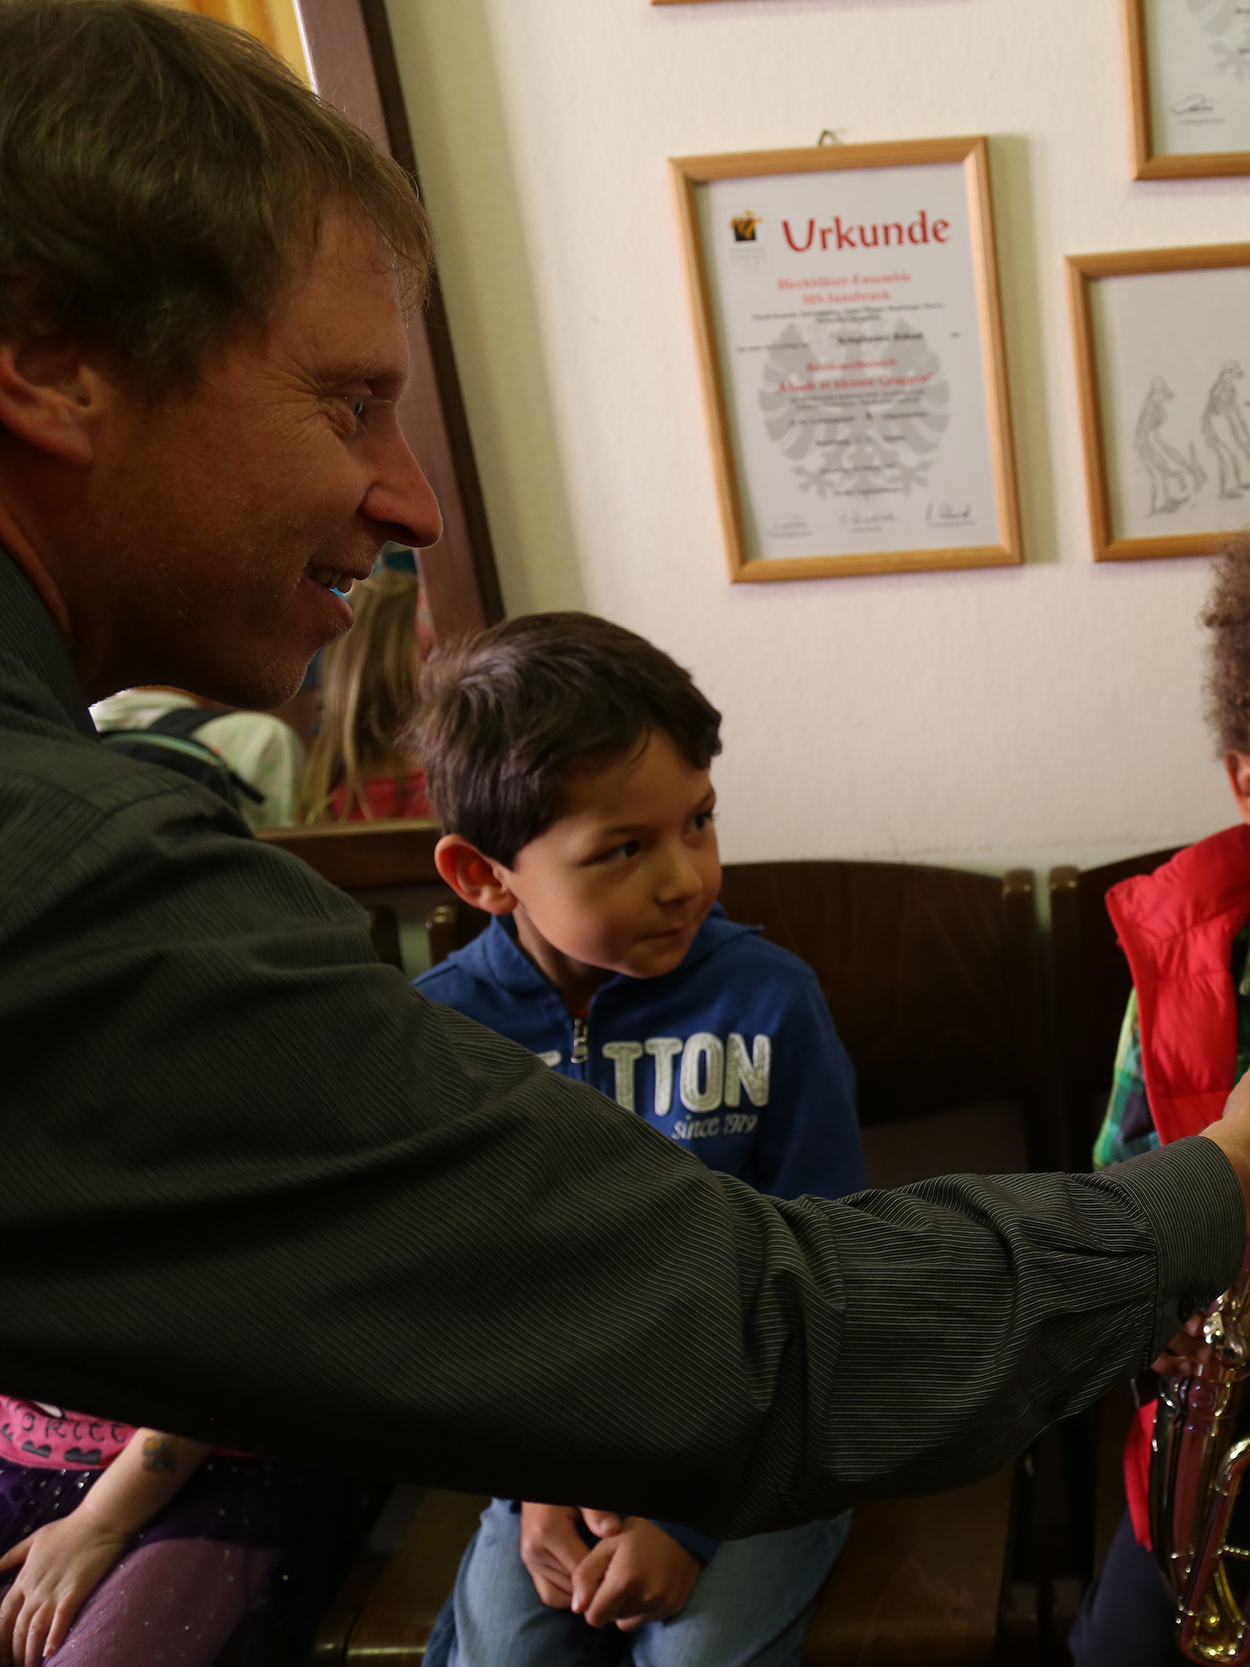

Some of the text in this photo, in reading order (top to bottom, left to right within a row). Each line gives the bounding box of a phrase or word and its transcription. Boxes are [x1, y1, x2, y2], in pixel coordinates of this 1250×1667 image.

[781, 209, 951, 253] Urkunde
[537, 1031, 772, 1117] TTON
[671, 1112, 758, 1141] since 1979
